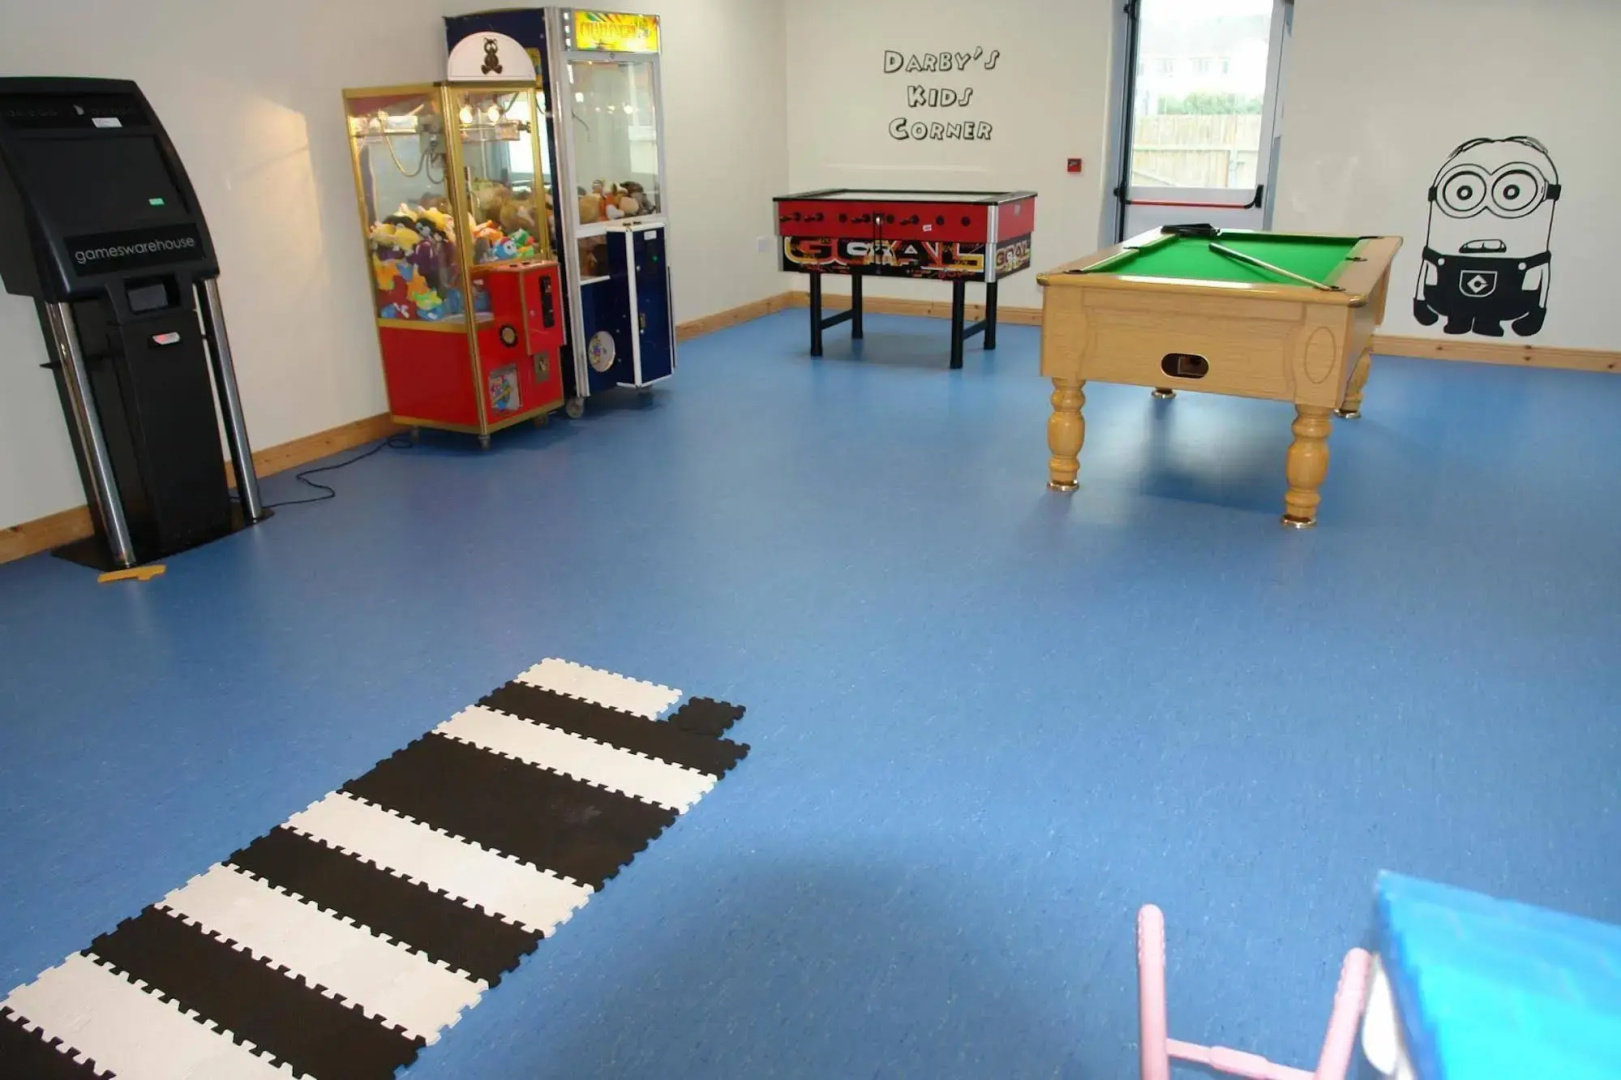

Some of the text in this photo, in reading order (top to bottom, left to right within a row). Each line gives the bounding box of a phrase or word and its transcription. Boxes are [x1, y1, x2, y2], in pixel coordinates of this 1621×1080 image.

[883, 46, 1000, 73] DARBY'S
[907, 85, 973, 108] KIDS
[888, 117, 993, 140] CORNER
[75, 237, 195, 264] gameswarehouse
